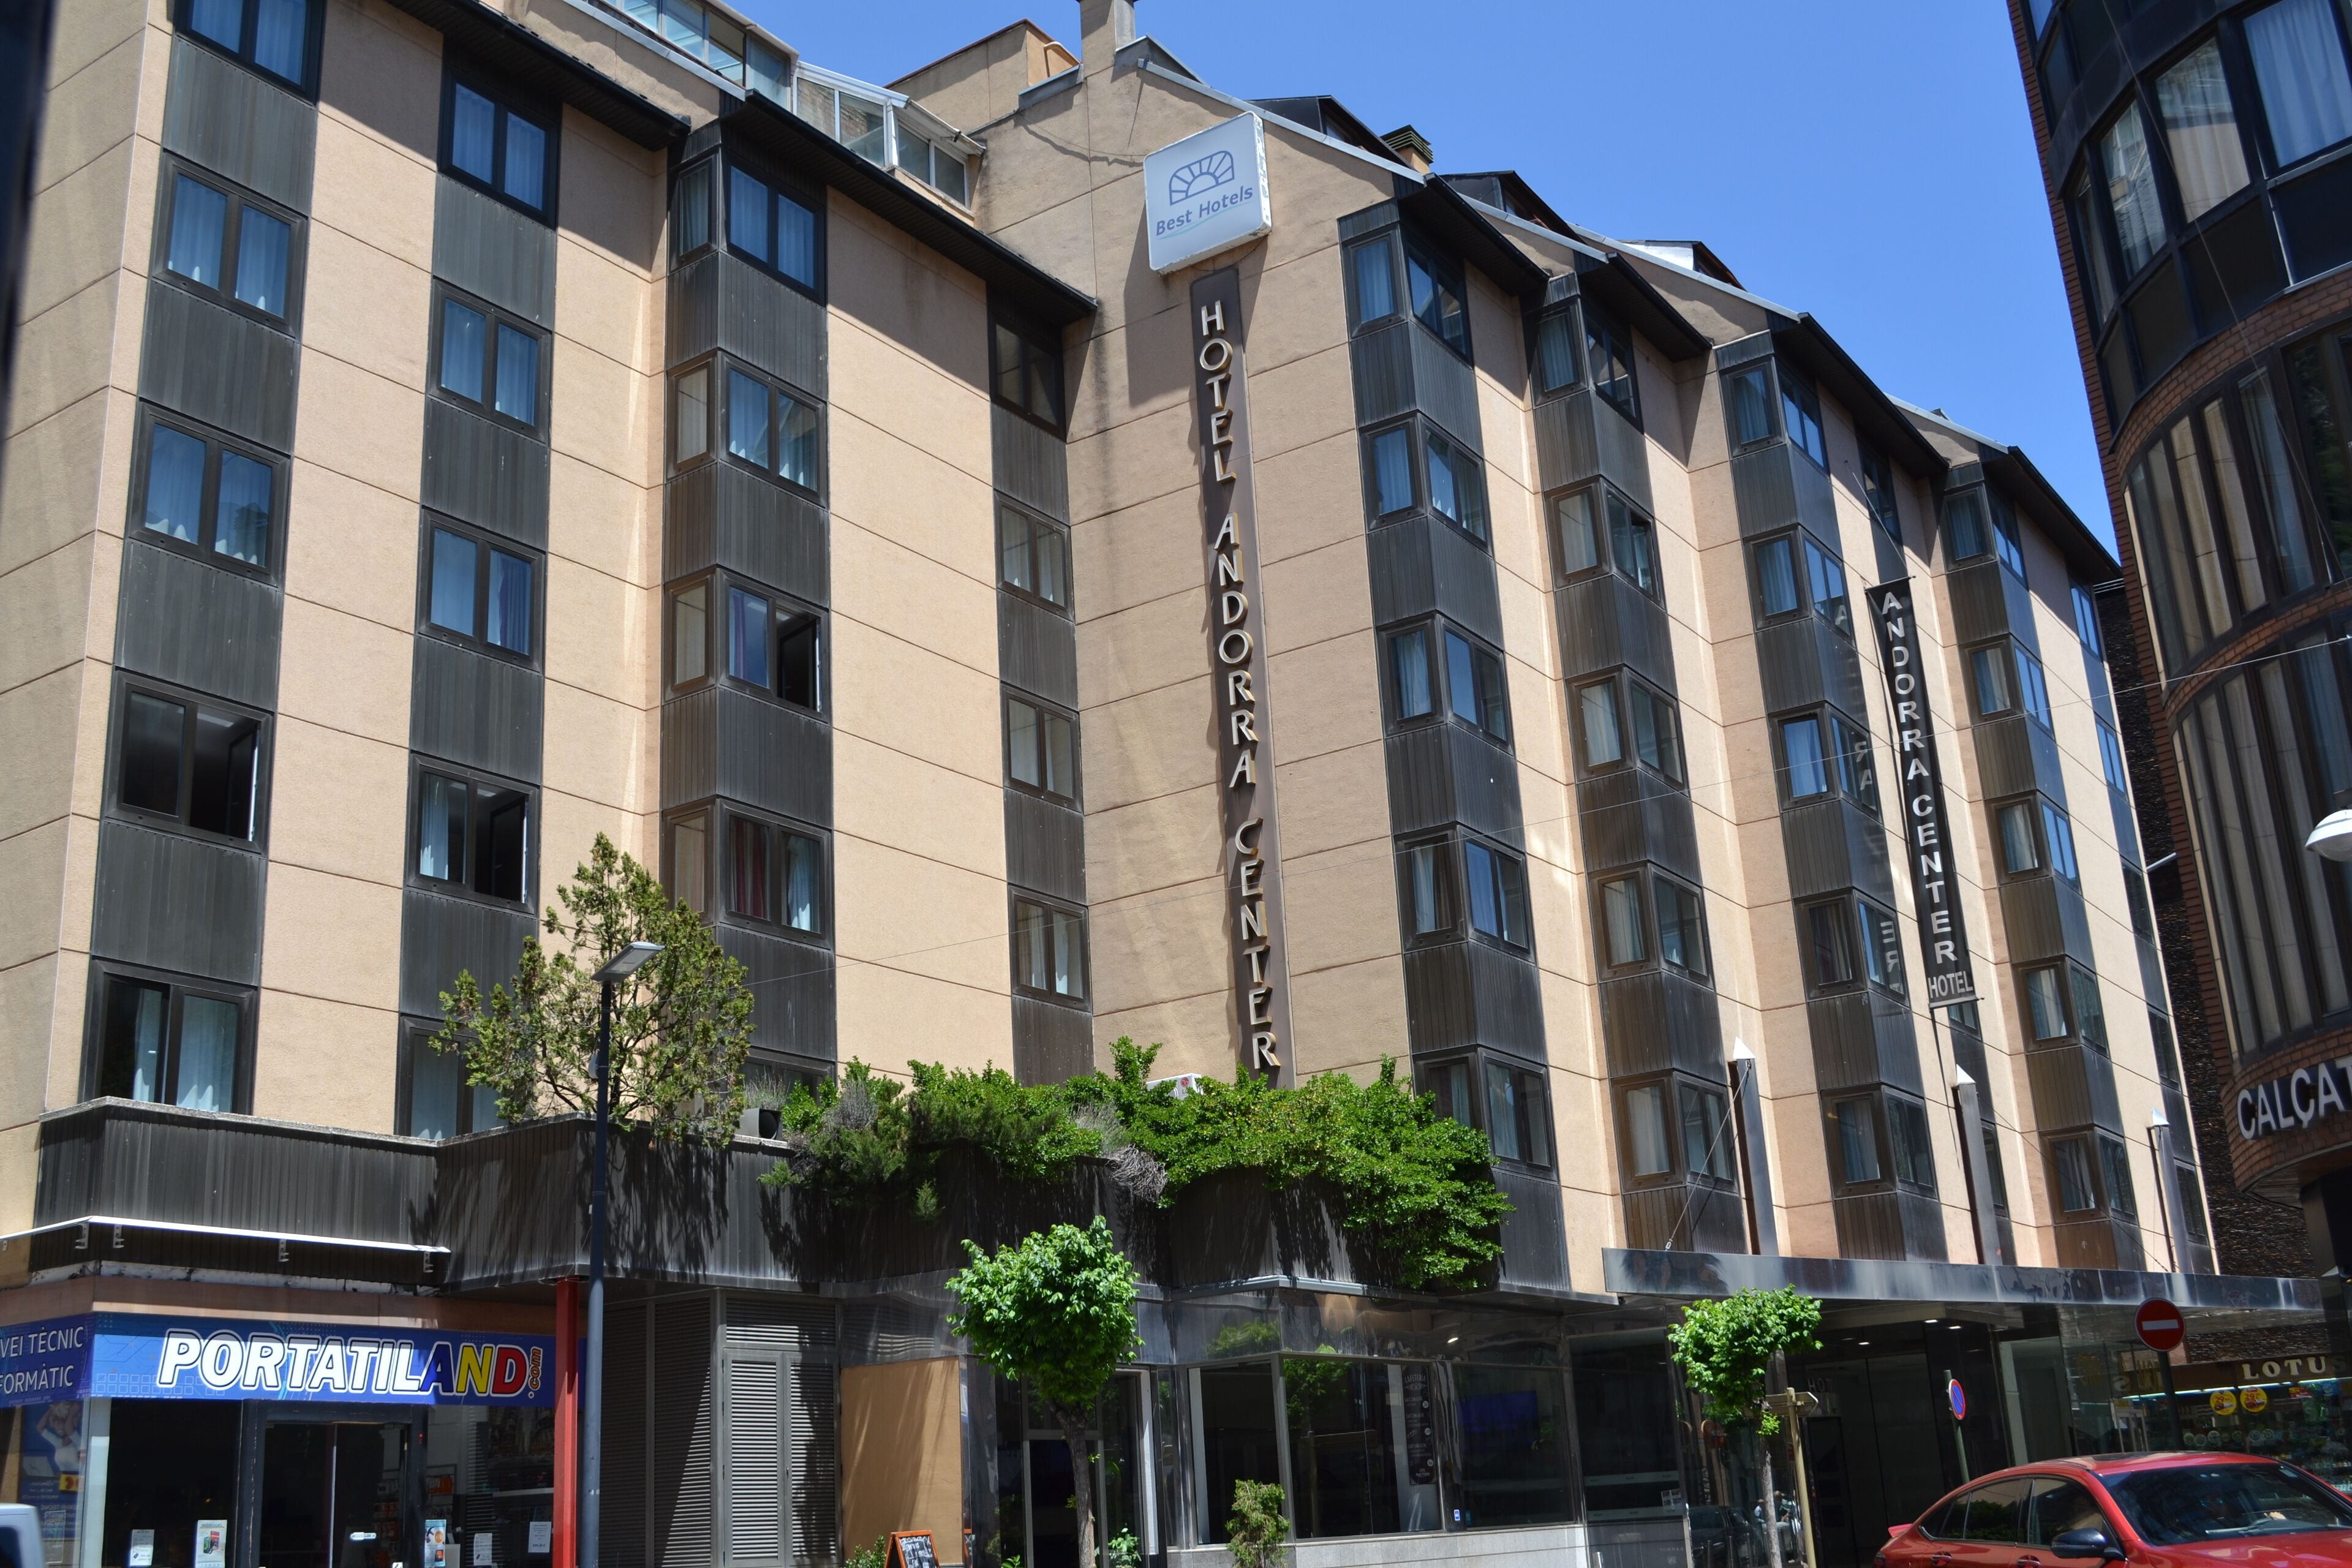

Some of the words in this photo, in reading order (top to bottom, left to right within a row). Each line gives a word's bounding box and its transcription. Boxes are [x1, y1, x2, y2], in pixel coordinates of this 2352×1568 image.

[1156, 209, 1193, 236] Best
[1199, 186, 1254, 218] Hotels
[1199, 300, 1236, 483] HOTEL
[1213, 511, 1259, 789] ANDORRA
[1882, 591, 1929, 781] ANDORRA
[1912, 794, 1958, 965] CENTER
[1234, 817, 1281, 1070] CENTER
[1928, 970, 1973, 1000] HOTEL
[28, 1326, 84, 1354] TÈCNIC
[157, 1329, 529, 1398] PORTATILAND
